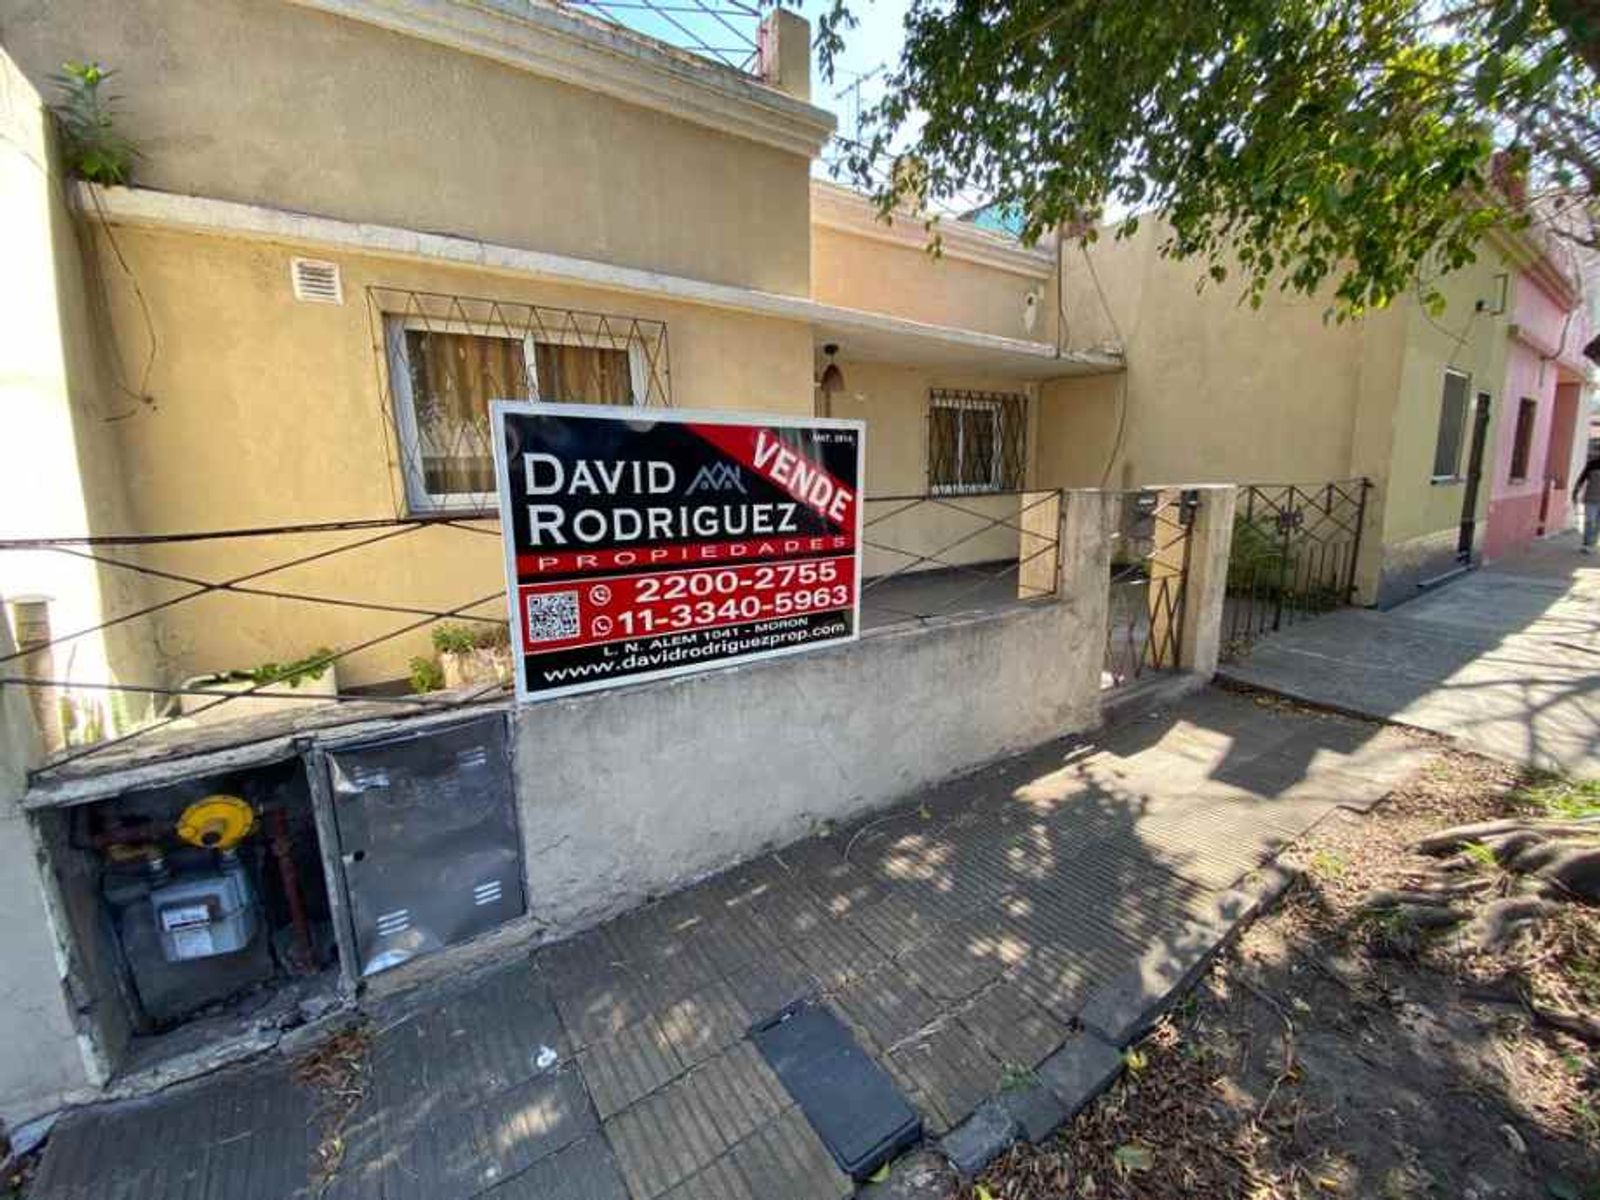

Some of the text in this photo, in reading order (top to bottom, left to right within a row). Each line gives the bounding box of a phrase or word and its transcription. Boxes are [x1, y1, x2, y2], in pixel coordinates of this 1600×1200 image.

[522, 453, 676, 495] DAVID
[753, 431, 853, 522] VENDE
[527, 502, 797, 546] RODRIGUEZ
[538, 537, 846, 571] PROPIEDADES
[635, 561, 836, 602] 2200-2755
[617, 585, 848, 634] 11-3340-5963
[543, 623, 846, 682] www.davidrodriguezprop.com
[603, 646, 619, 657] L.
[624, 642, 643, 653] N.
[649, 634, 698, 649] ALEM
[754, 616, 809, 634] MORON
